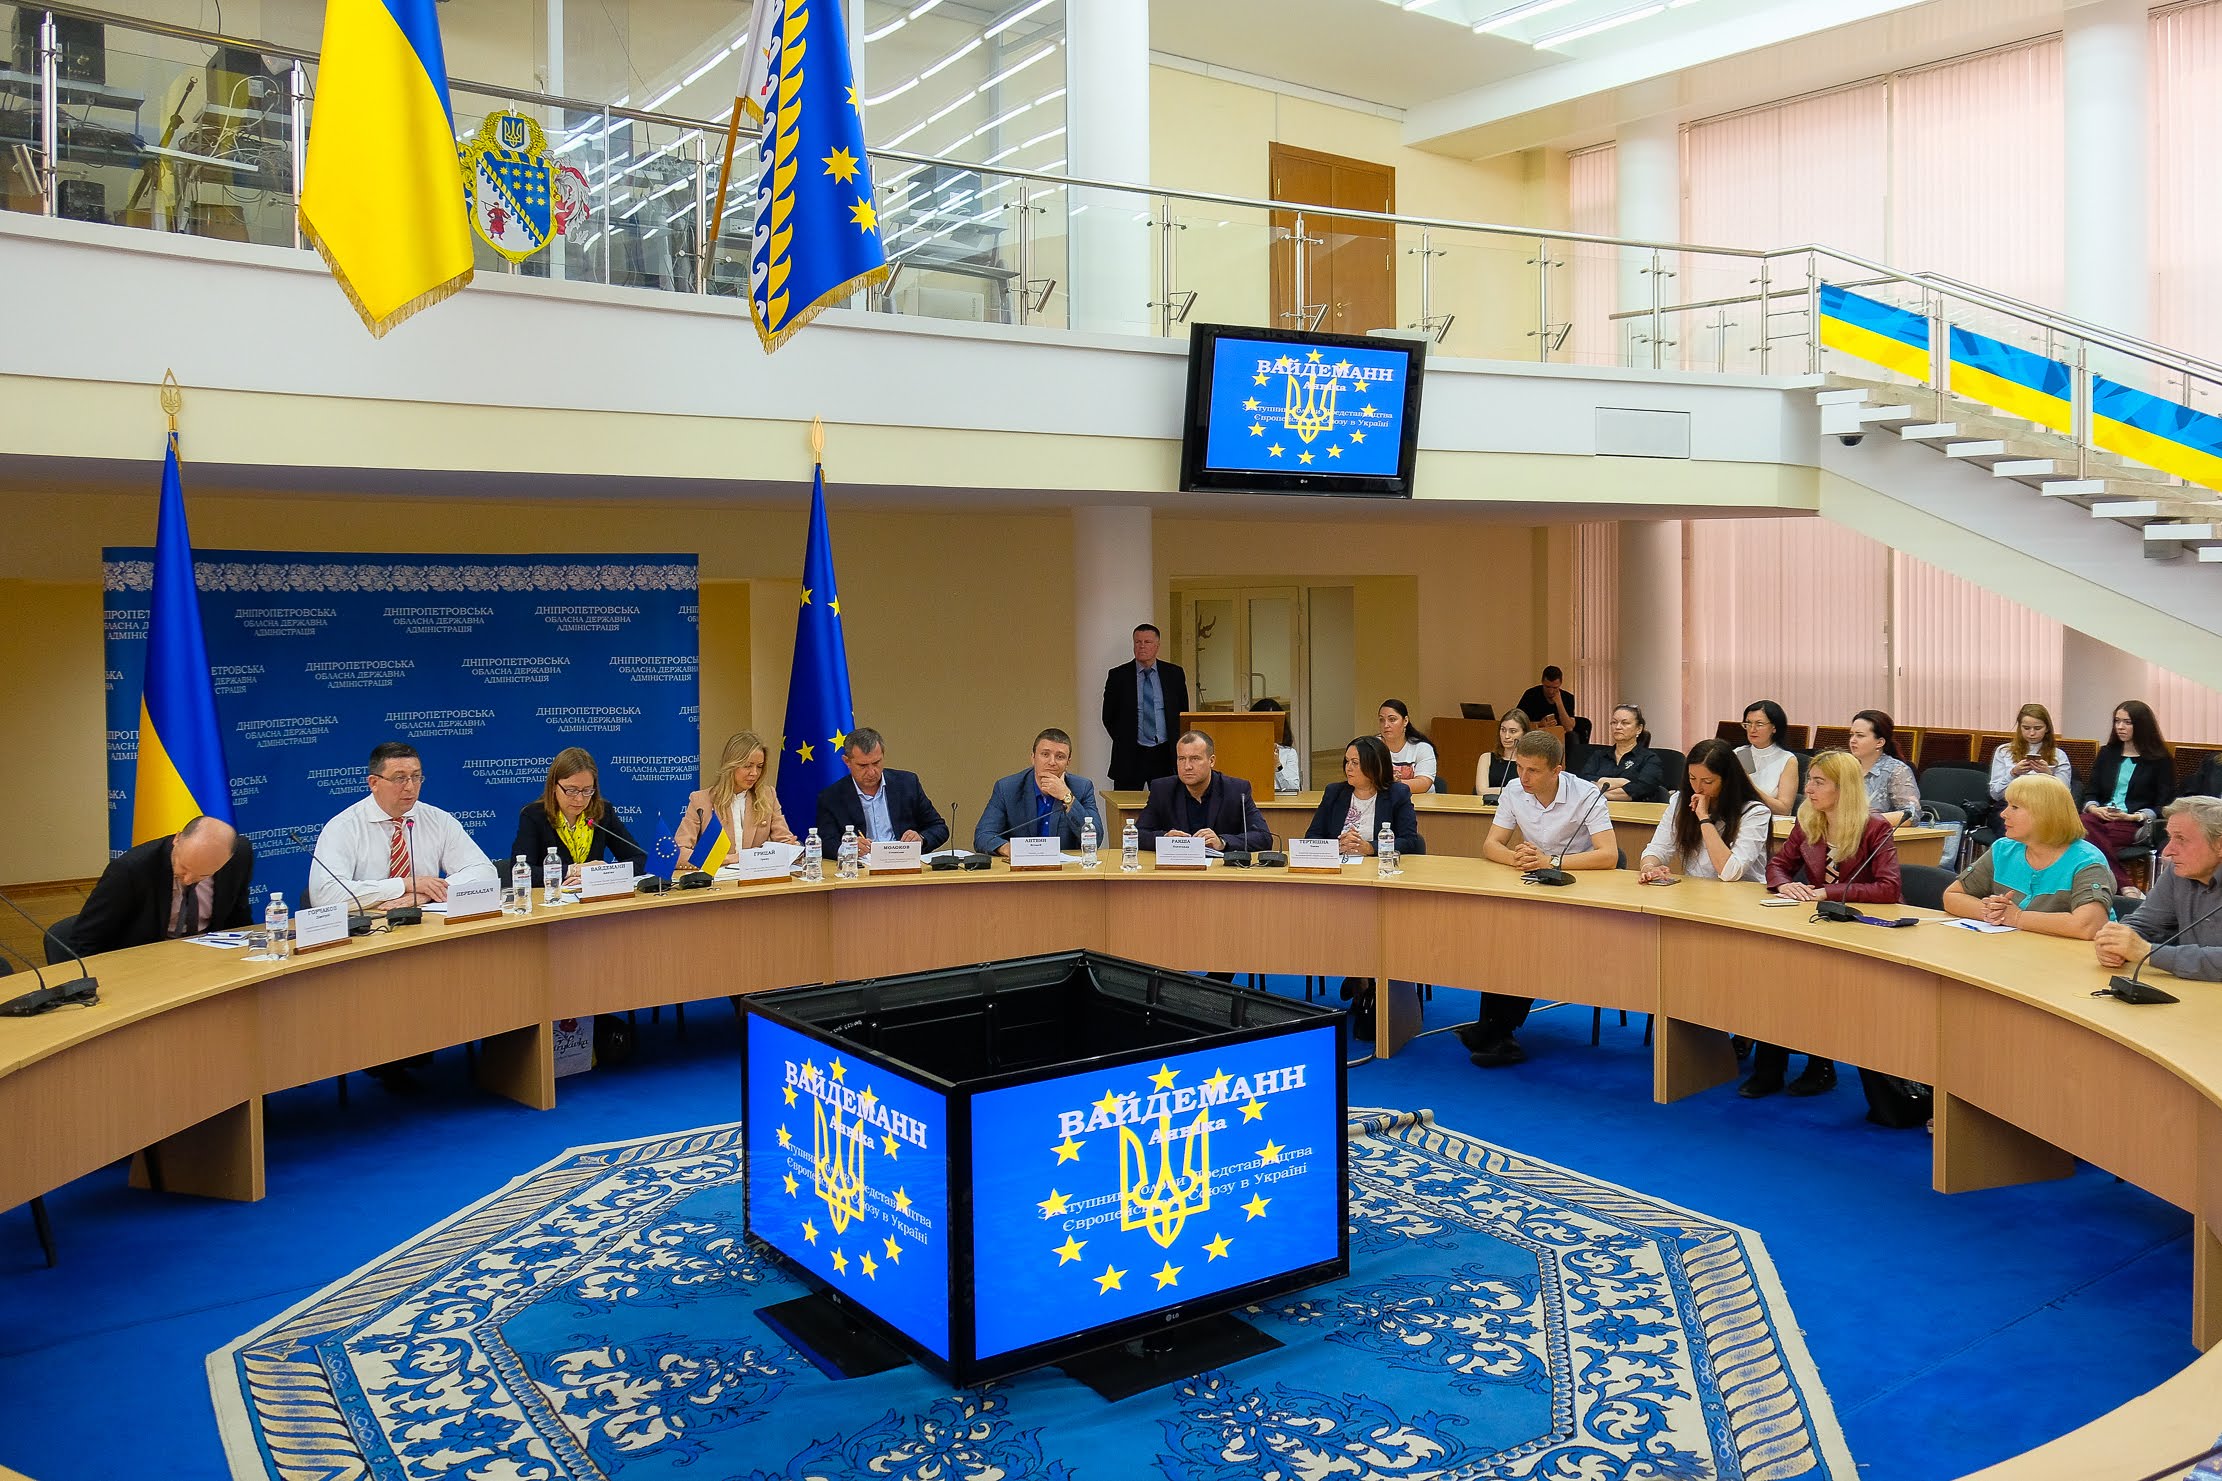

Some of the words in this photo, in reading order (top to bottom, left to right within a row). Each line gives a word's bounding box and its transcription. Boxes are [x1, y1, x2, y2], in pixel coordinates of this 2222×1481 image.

[1256, 358, 1394, 382] ВАЙДЕМАНН
[1358, 419, 1390, 428] Україні
[235, 607, 337, 619] ДНІПРОПЕТРОВСЬКА
[383, 607, 494, 617] ДНІПРОПЕТРОВСЬКА
[534, 606, 640, 616] ДНІПРОПЕТРОВСЬКА
[243, 619, 278, 628] ОБЛАСНА
[280, 618, 328, 627] ДЕРЖАВНА
[393, 617, 434, 626] ОБЛАСНА
[436, 616, 485, 625] ДЕРЖАВНА
[545, 616, 583, 624] ОБЛАСНА
[585, 615, 631, 624] ДЕРЖАВНА
[254, 627, 316, 637] АДМІНІСТРАЦІЯ
[406, 625, 472, 634] АДМІНІСТРАЦІЯ
[556, 624, 620, 632] АДМІНІСТРАЦІЯ
[108, 632, 148, 640] АДМІНІС
[305, 660, 415, 672] ДНІПРОПЕТРОВСЬКА
[461, 656, 571, 667] ДНІПРОПЕТРОВСЬКА
[211, 665, 265, 676] ЕТРОВСЬКА
[472, 667, 513, 676] ОБЛАСНА
[514, 666, 562, 675] ДЕРЖАВНА
[618, 666, 657, 674] ОБЛАСНА
[315, 671, 357, 681] ОБЛАСНА
[358, 670, 406, 680] ДЕРЖАВНА
[484, 675, 550, 684] АДМІНІСТРАЦІЯ
[630, 674, 692, 682] АДМІНІСТРАЦІЯ
[214, 676, 257, 686] ДЕРЖАВНА
[327, 679, 393, 689] АДМІНІСТРАЦІЯ
[215, 686, 247, 695] СТРАЦІЯ
[384, 709, 495, 722] ДНІПРОПЕТРОВСЬКА
[535, 706, 641, 717] ДНІПРОПЕТРОВСЬКА
[236, 716, 338, 731] ДНІПРОПЕТРОВСЬКА
[394, 721, 436, 731] ОБЛАСНА
[437, 719, 486, 729] ДЕРЖАВНА
[545, 716, 584, 725] ОБЛАСНА
[585, 715, 633, 724] ДЕРЖАВНА
[245, 730, 282, 740] ОБЛАСНА
[282, 727, 329, 738] ДЕРЖАВНА
[407, 728, 473, 738] АДМІНІСТРАЦІЯ
[557, 724, 621, 733] АДМІНІСТРАЦІЯ
[256, 736, 317, 748] АДМІНІСТРАЦІЯ
[462, 757, 554, 769] ДНІПРОПЕТРОВС
[307, 766, 369, 780] ДНІПРОПЕТ
[472, 769, 514, 777] ОБЛАСНА
[620, 765, 657, 773] ОБЛАСНА
[631, 773, 693, 781] АДМІНІСТРАЦІЯ
[317, 778, 357, 788] ОБЛАСНА
[329, 785, 371, 795] АДМІНІСТ
[252, 839, 284, 850] БЛАСНА
[456, 887, 494, 897] ПЕРЕКЛАДАЧ
[784, 1060, 928, 1149] ВАЙДЕМАНН
[1057, 1064, 1307, 1138] ВАЙДЕМАНН
[1240, 1179, 1250, 1189] в
[1254, 1162, 1308, 1185] Україні
[891, 1214, 928, 1246] Україні
